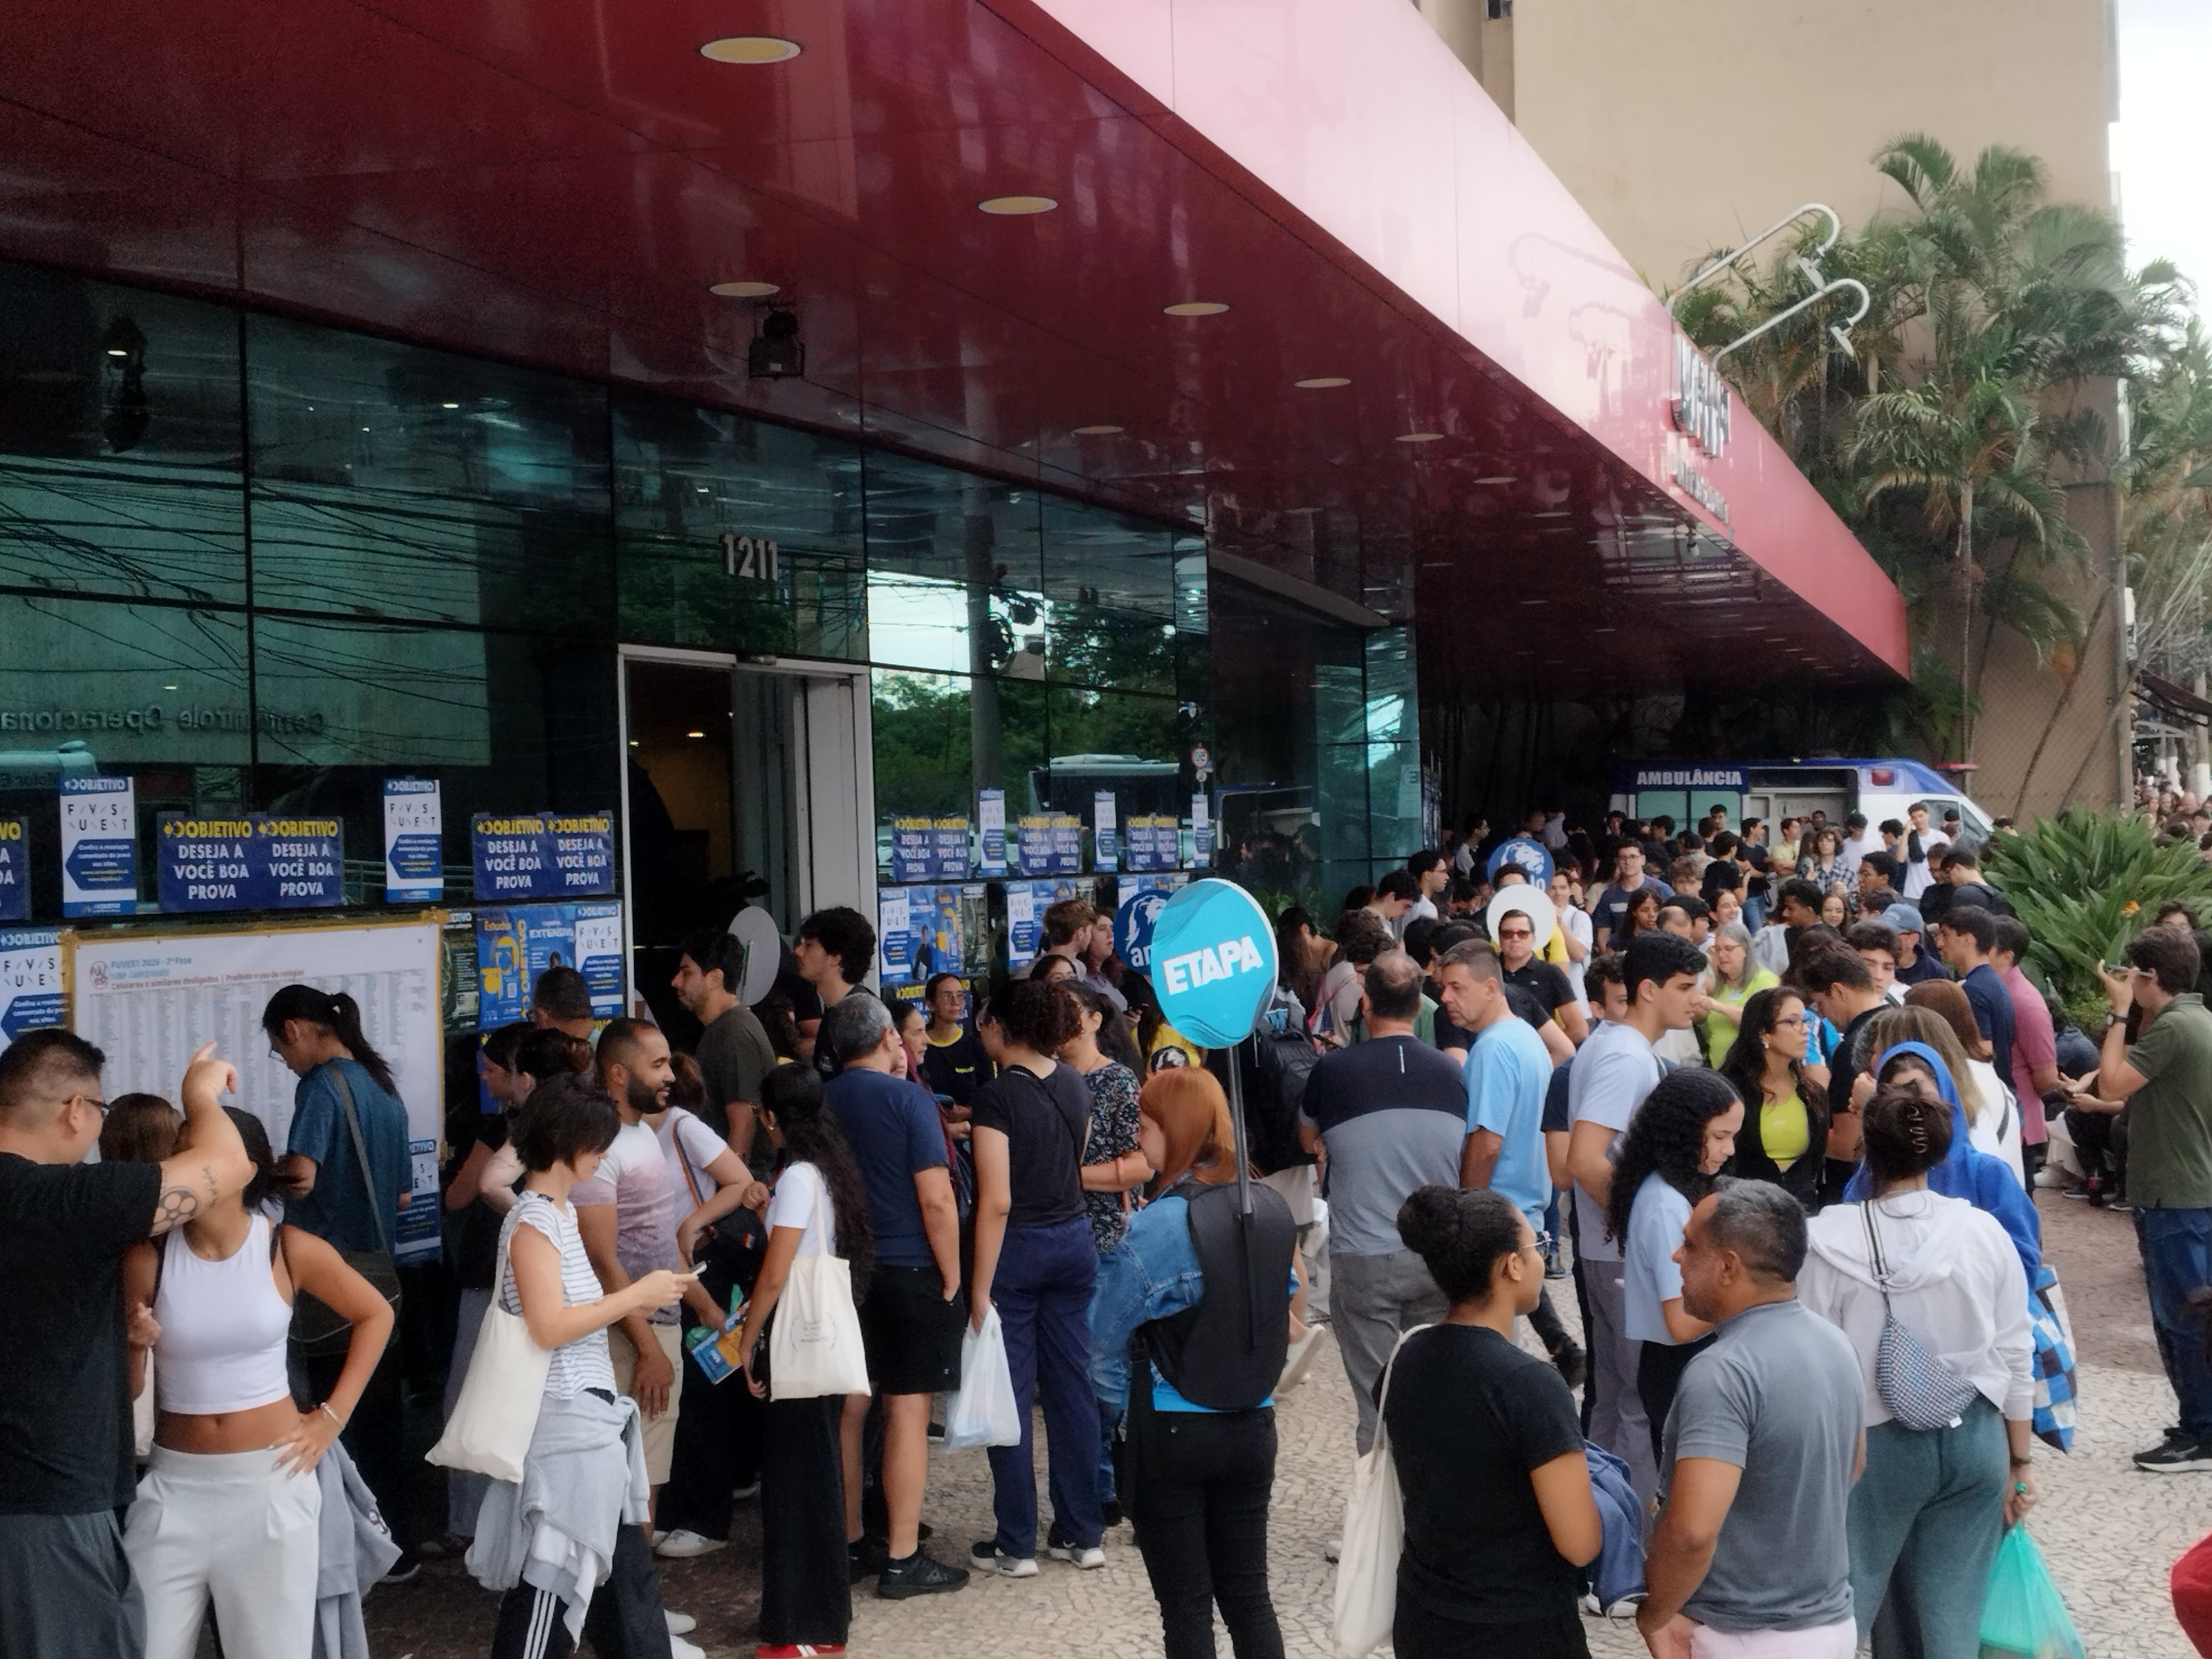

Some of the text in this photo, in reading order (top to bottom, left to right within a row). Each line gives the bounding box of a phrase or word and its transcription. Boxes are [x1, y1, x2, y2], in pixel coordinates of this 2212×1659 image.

[724, 534, 778, 581] 1211
[1637, 768, 1742, 785] AMBULÂNCIA
[80, 779, 126, 791] OBJETIVO
[186, 821, 253, 838] OBJETIVO
[278, 820, 338, 837] OBJETIVO
[493, 818, 544, 835] OBJETIVO
[562, 817, 609, 834] OBJETIVO
[179, 843, 244, 859] DESEJA A
[272, 843, 331, 858] DESEJA A
[488, 839, 539, 854] DESEJA A
[557, 838, 604, 852] DESEJA A
[269, 858, 335, 878] VOCÊ BOA
[486, 854, 542, 872] VOCÊ BOA
[556, 852, 607, 868] VOCÊ BOA
[174, 859, 249, 879] VOCÊ BOA
[496, 874, 533, 889] PROVA
[566, 872, 599, 886] PROVA
[188, 884, 237, 900] PROVA
[280, 881, 324, 896] PROVA
[111, 959, 139, 969] FUVEST
[175, 957, 192, 965] Fase
[1162, 935, 1265, 995] ETAPA
[112, 982, 144, 990] Celulares
[150, 978, 181, 987] similares
[183, 975, 219, 985] desligados
